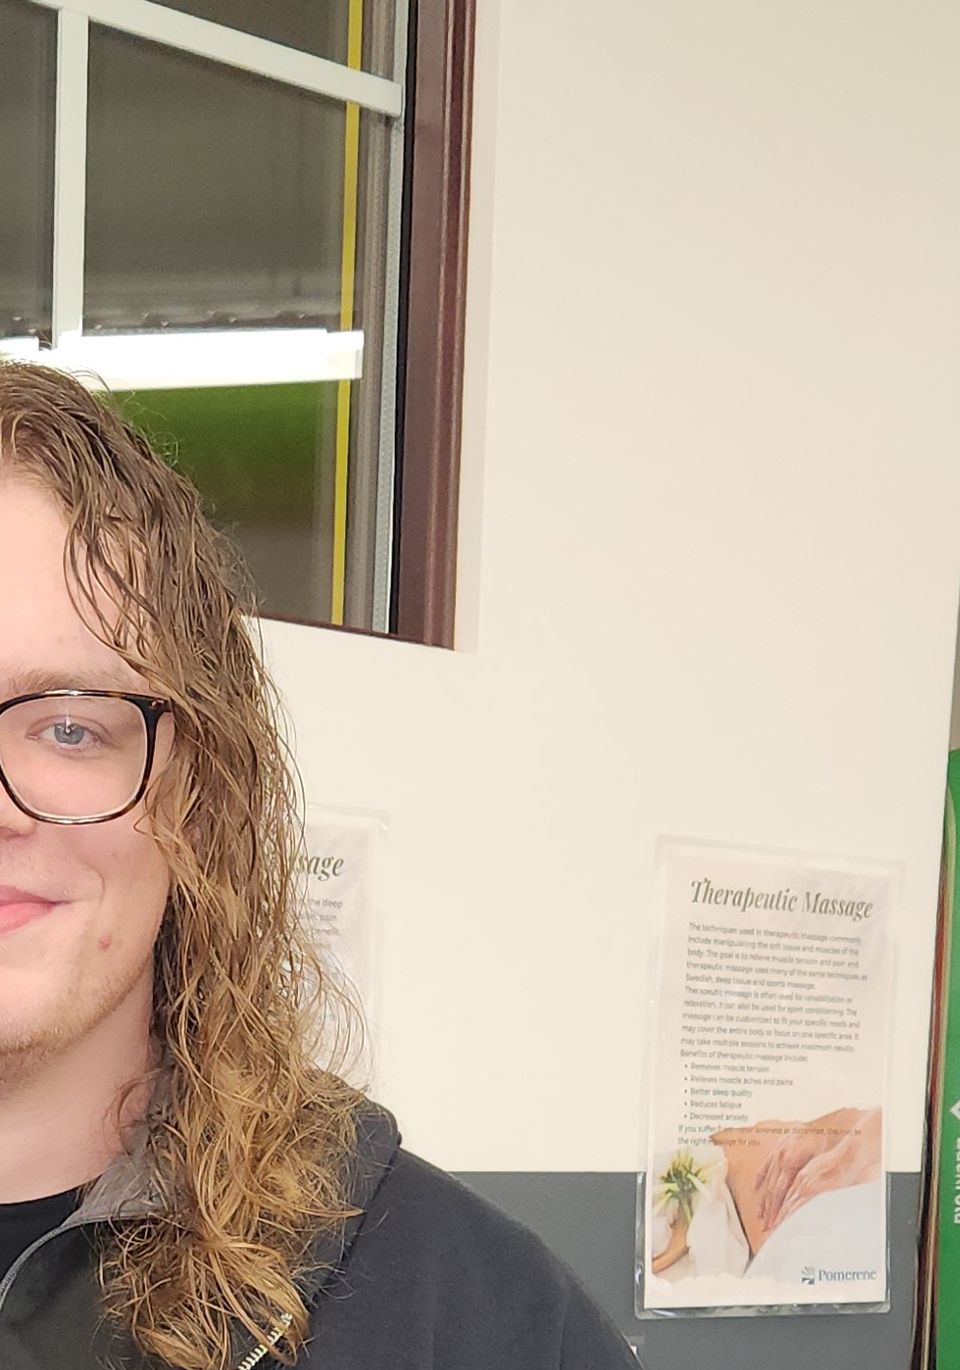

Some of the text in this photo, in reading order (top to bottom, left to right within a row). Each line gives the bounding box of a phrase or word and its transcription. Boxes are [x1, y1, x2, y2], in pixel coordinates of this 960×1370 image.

[691, 878, 873, 921] Therapeutic Massage
[818, 1269, 877, 1281] Pomerene
